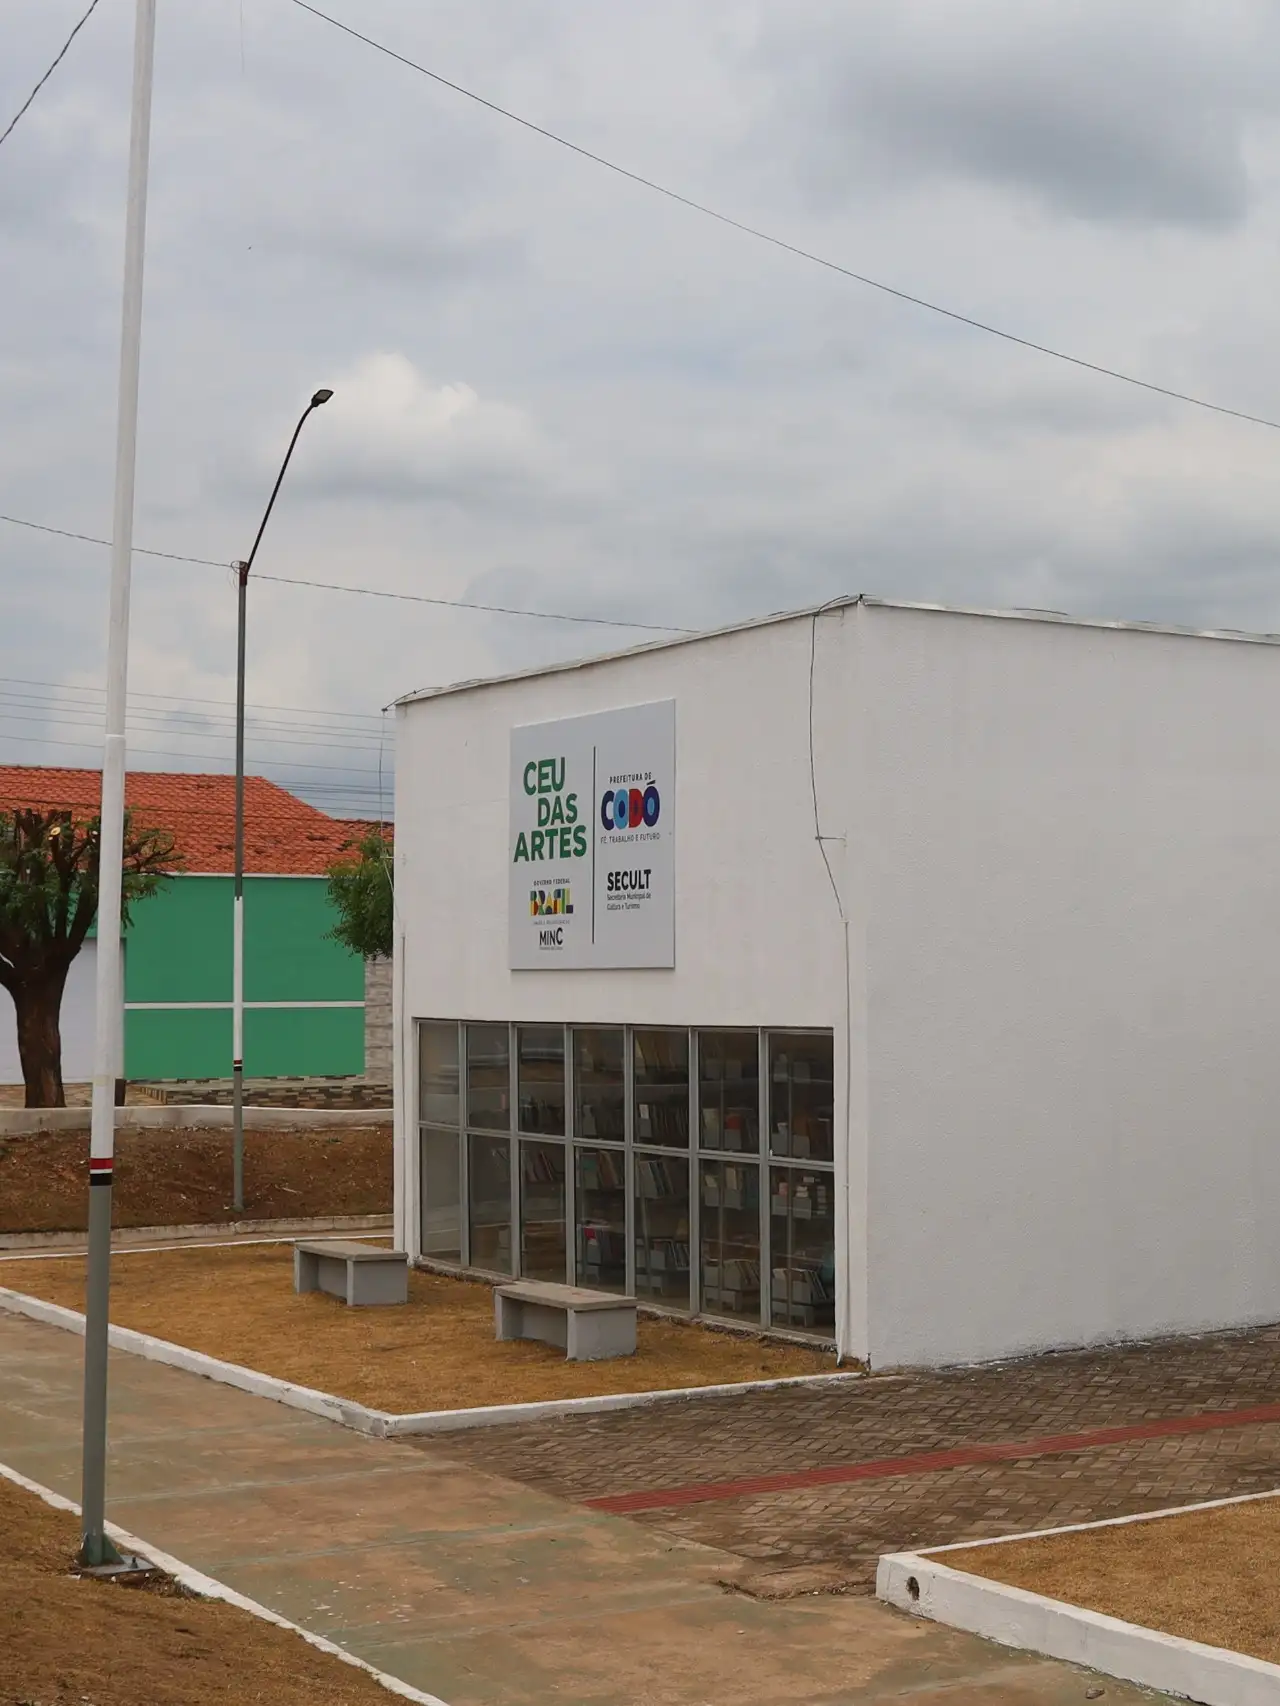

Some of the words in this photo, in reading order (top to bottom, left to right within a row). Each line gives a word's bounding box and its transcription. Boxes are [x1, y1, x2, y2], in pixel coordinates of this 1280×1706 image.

[523, 757, 565, 796] CEU
[610, 773, 643, 784] PREFEITURA
[644, 772, 652, 781] DE
[538, 793, 578, 827] DAS
[600, 780, 660, 831] CODÓ
[513, 825, 587, 862] ARTES
[609, 834, 635, 843] TRABALHO
[640, 832, 660, 841] FUTURO
[607, 869, 651, 891] SECULT
[530, 888, 573, 916] BRASIL
